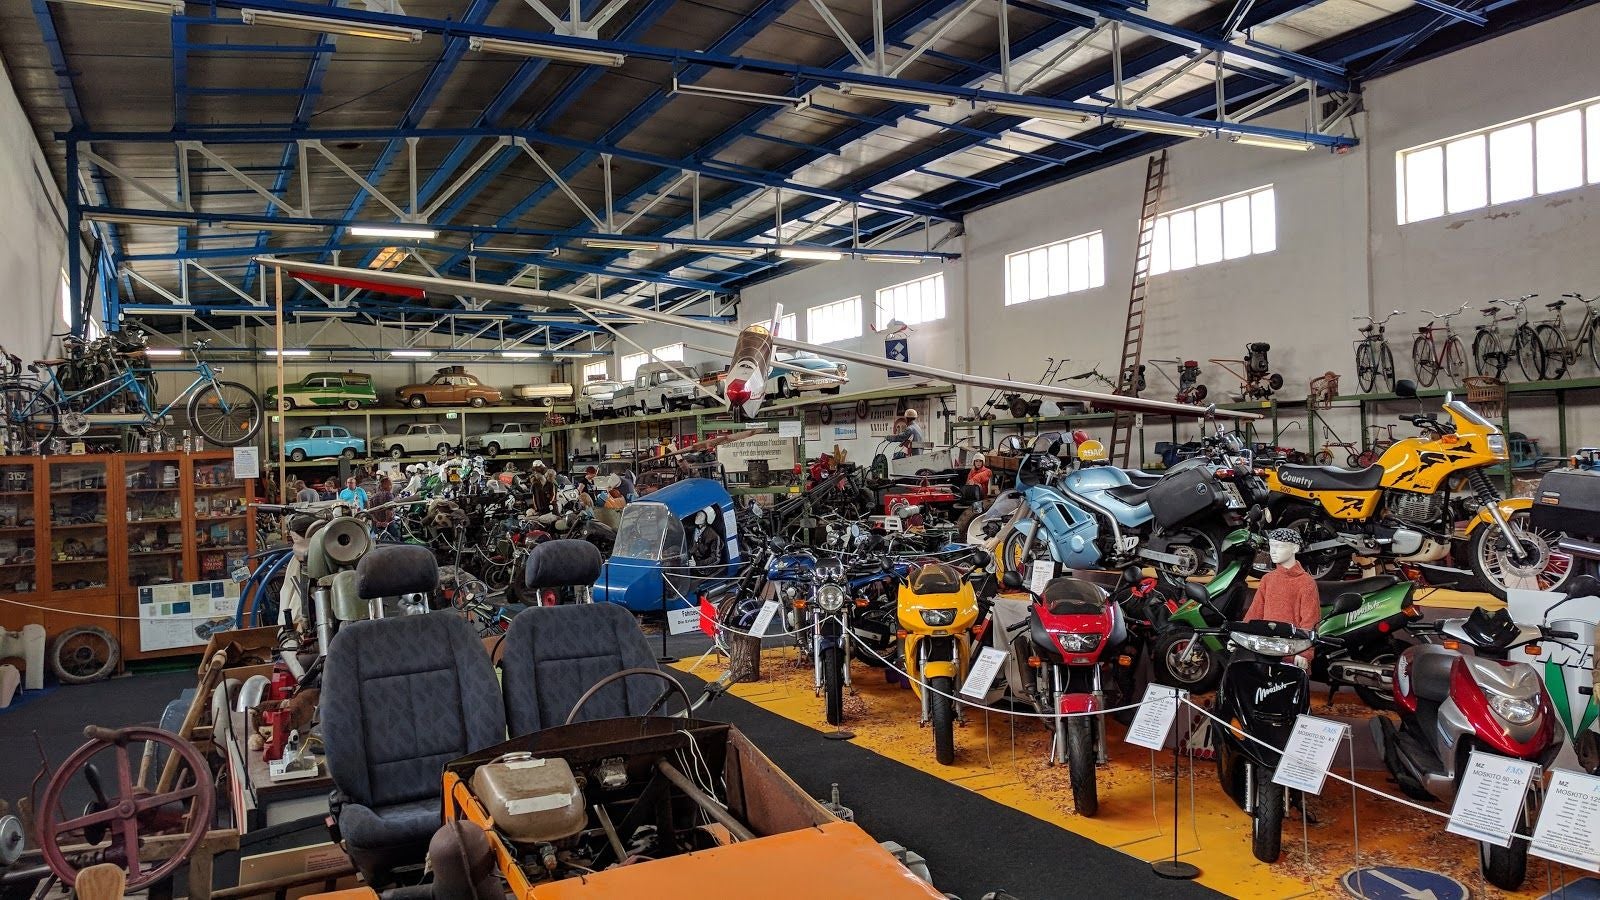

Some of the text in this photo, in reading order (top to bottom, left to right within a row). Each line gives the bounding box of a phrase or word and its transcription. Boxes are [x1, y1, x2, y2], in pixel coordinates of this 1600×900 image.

[1281, 471, 1314, 488] Country
[1472, 769, 1501, 780] MOSKITO
[1556, 787, 1589, 800] MOSKITO
